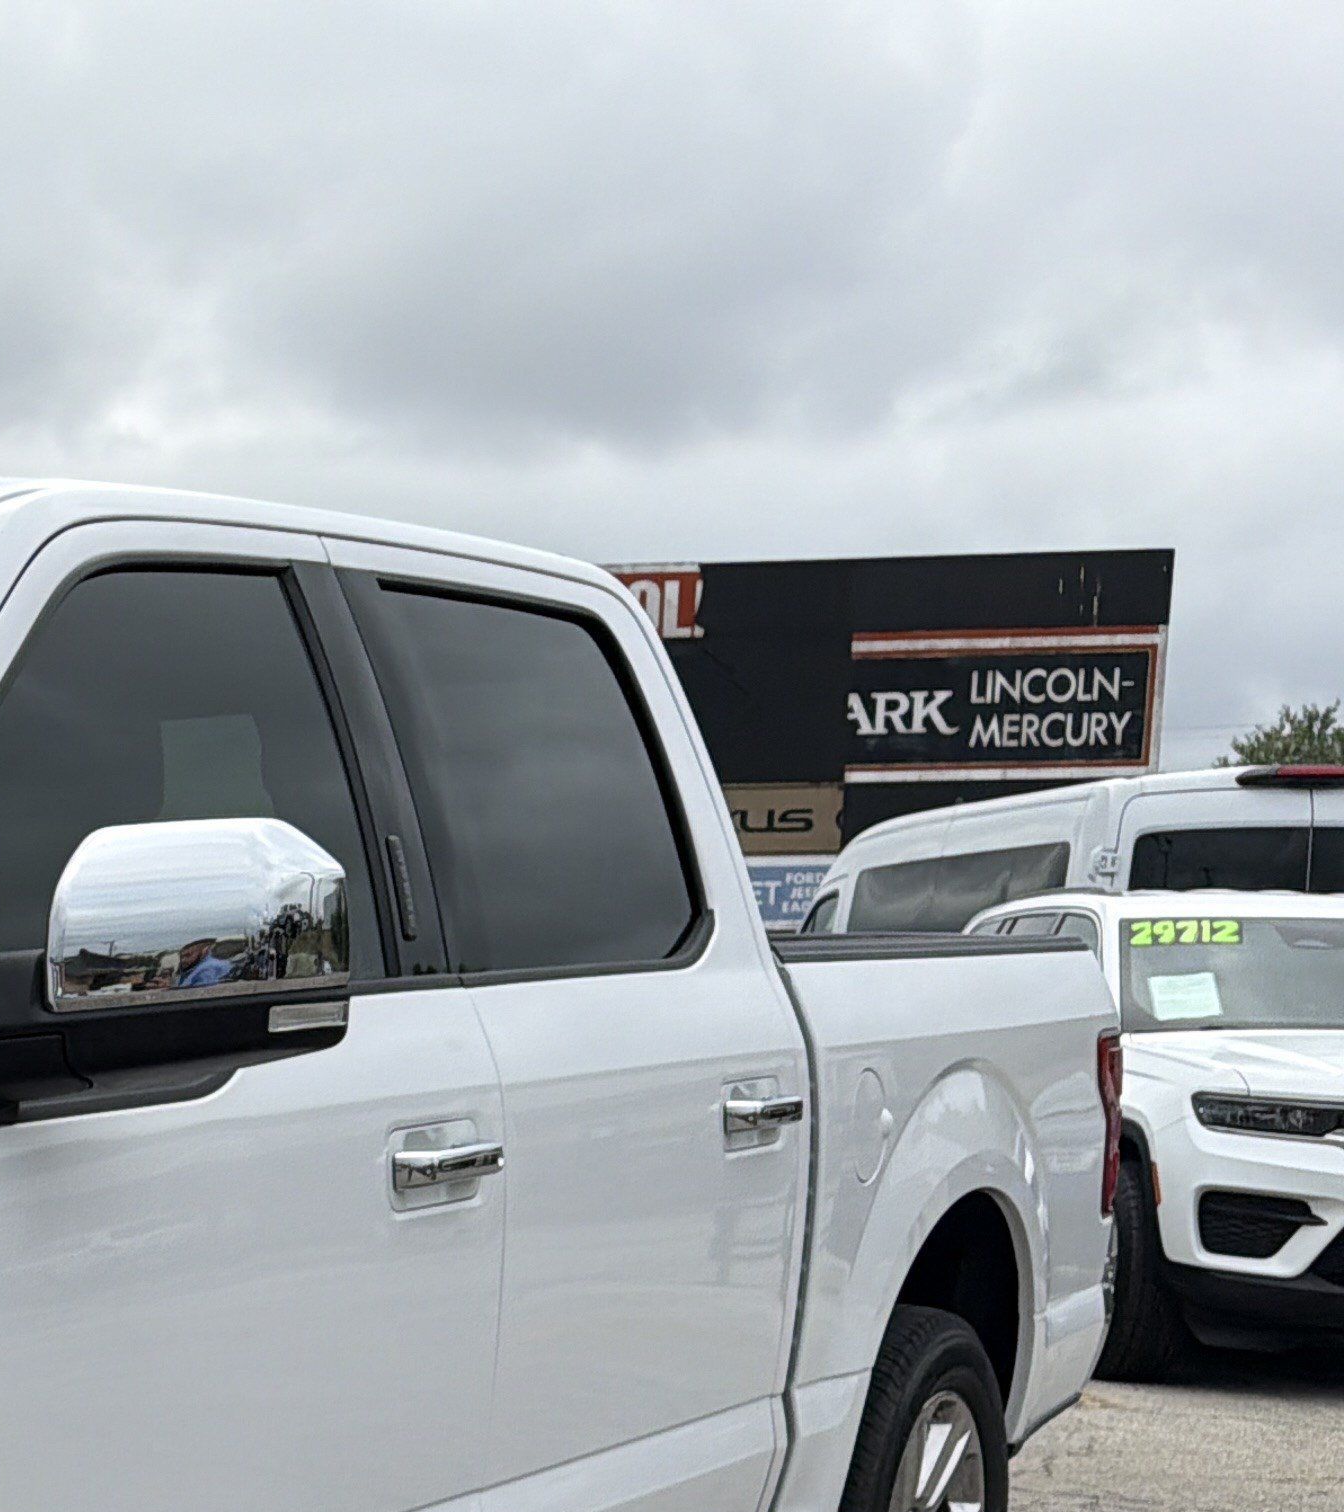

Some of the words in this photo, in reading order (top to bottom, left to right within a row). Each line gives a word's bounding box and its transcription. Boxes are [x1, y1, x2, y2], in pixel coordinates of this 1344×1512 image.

[970, 666, 1135, 704] LINCOLN-
[968, 711, 1133, 748] MERCURY
[1129, 919, 1240, 945] 29712
